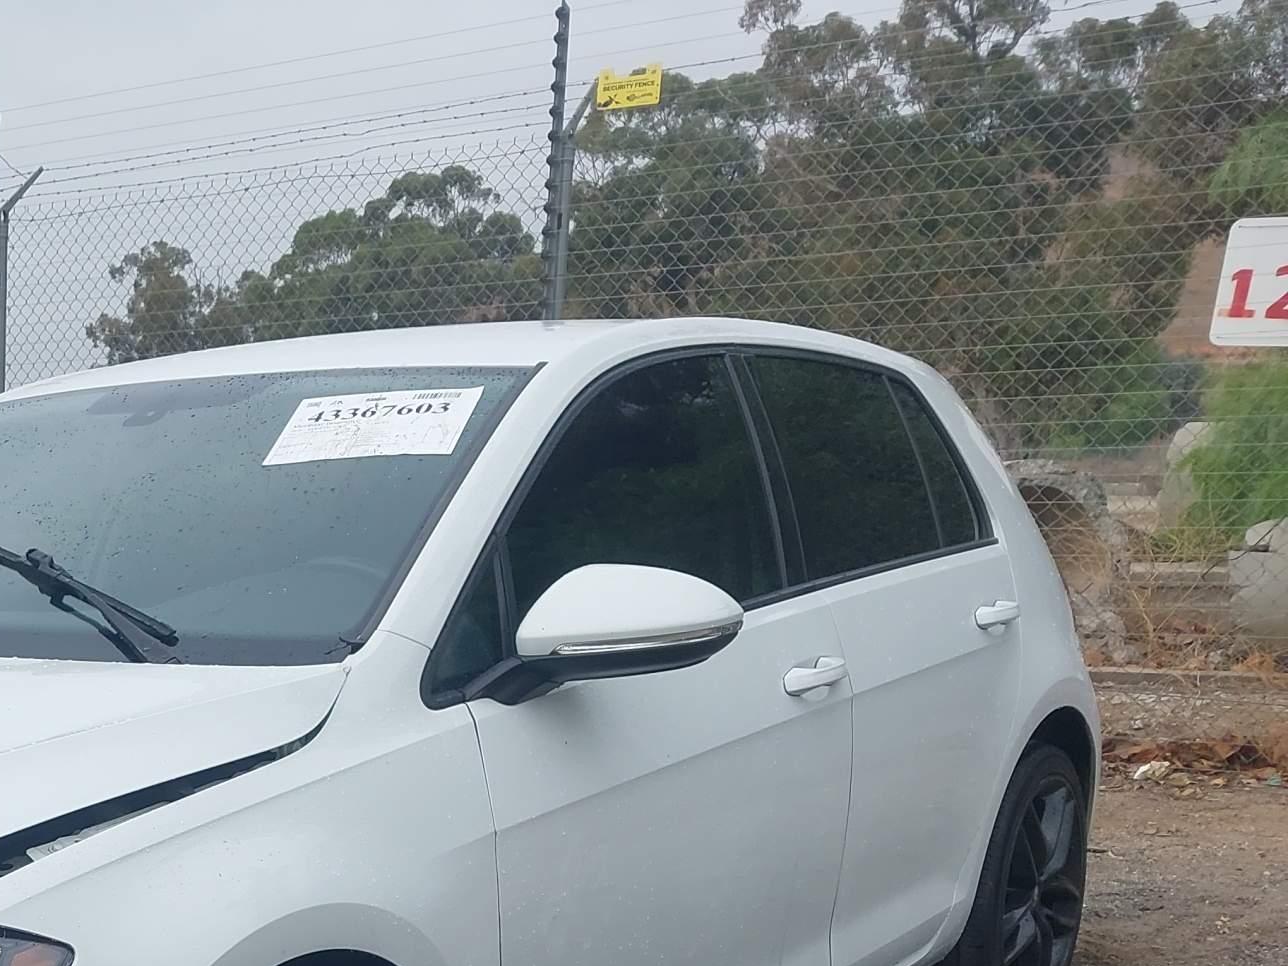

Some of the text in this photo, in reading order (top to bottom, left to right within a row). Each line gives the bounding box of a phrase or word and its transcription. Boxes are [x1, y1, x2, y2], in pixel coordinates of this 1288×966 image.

[603, 83, 633, 92] SECURITY
[634, 80, 655, 89] FENCE
[307, 402, 452, 423] 43367603
